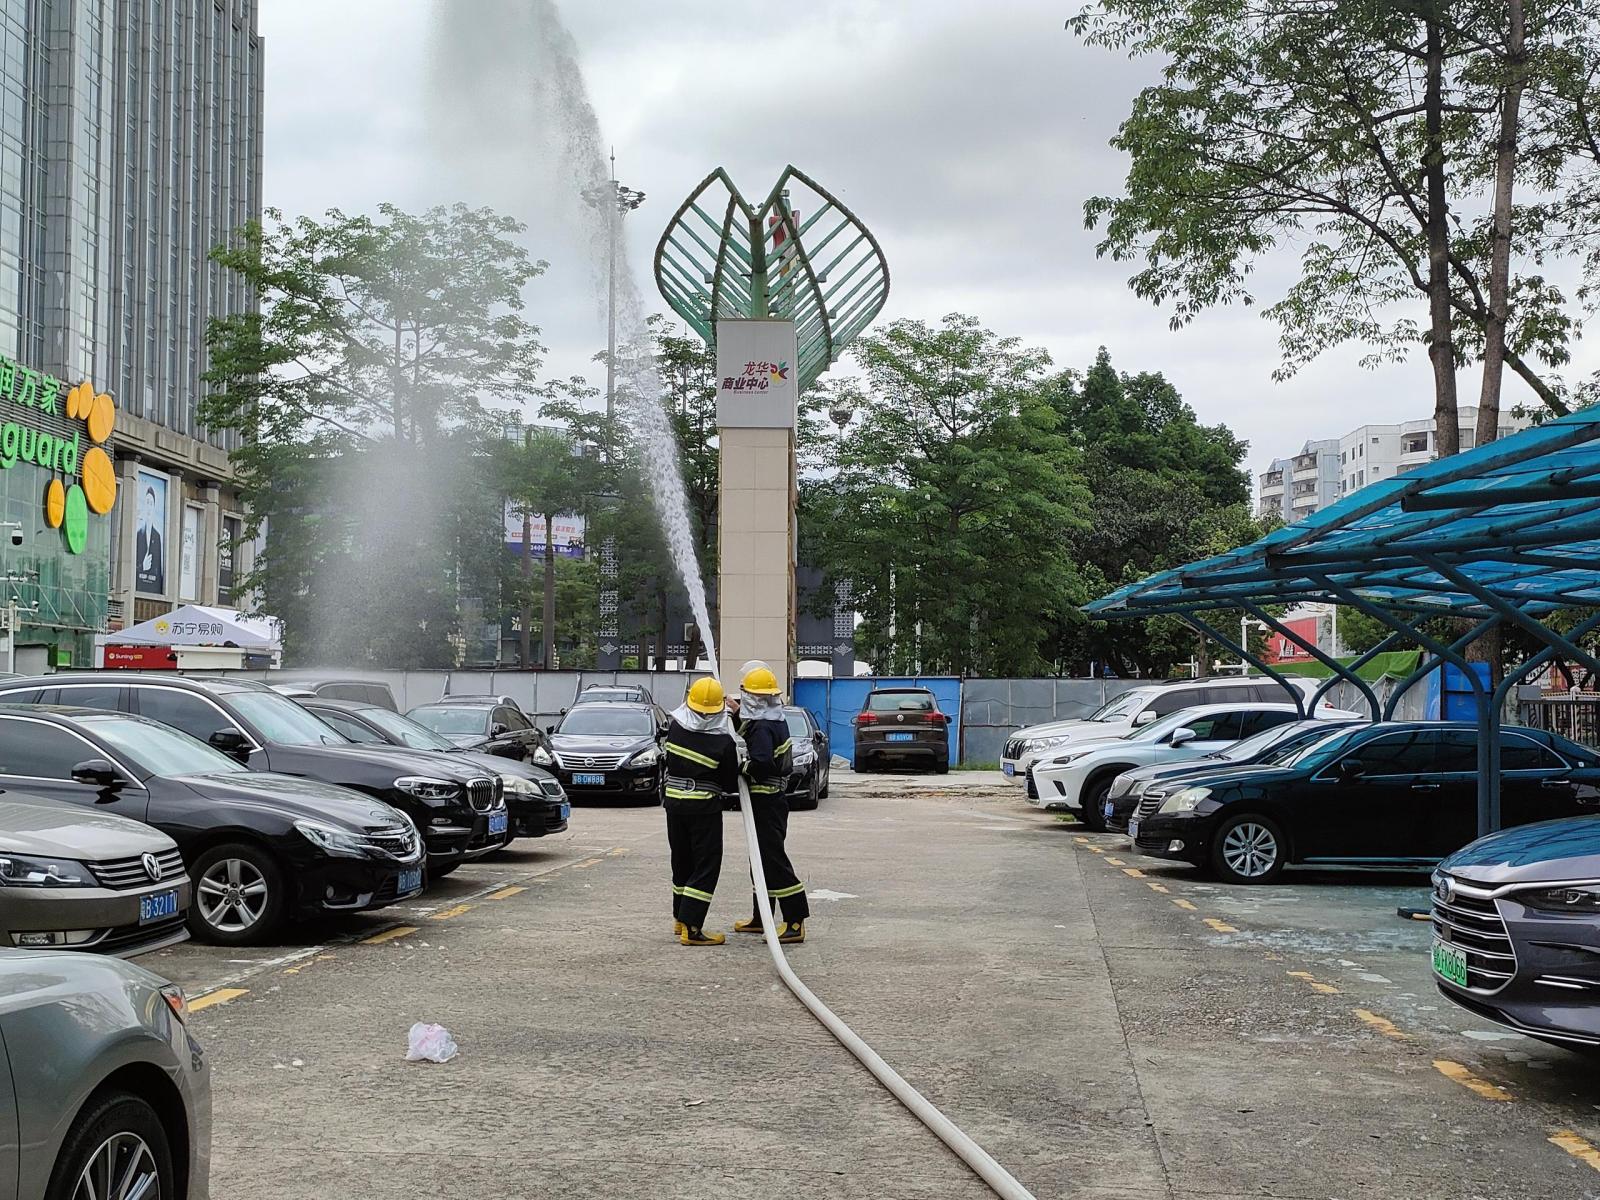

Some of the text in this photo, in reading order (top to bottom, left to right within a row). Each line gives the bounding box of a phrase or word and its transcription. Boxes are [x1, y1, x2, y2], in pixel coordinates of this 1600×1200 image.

[742, 361, 769, 376] 龙华
[721, 377, 769, 390] 商业中心
[172, 622, 224, 636] 苏宁易购
[115, 653, 134, 661] Suning
